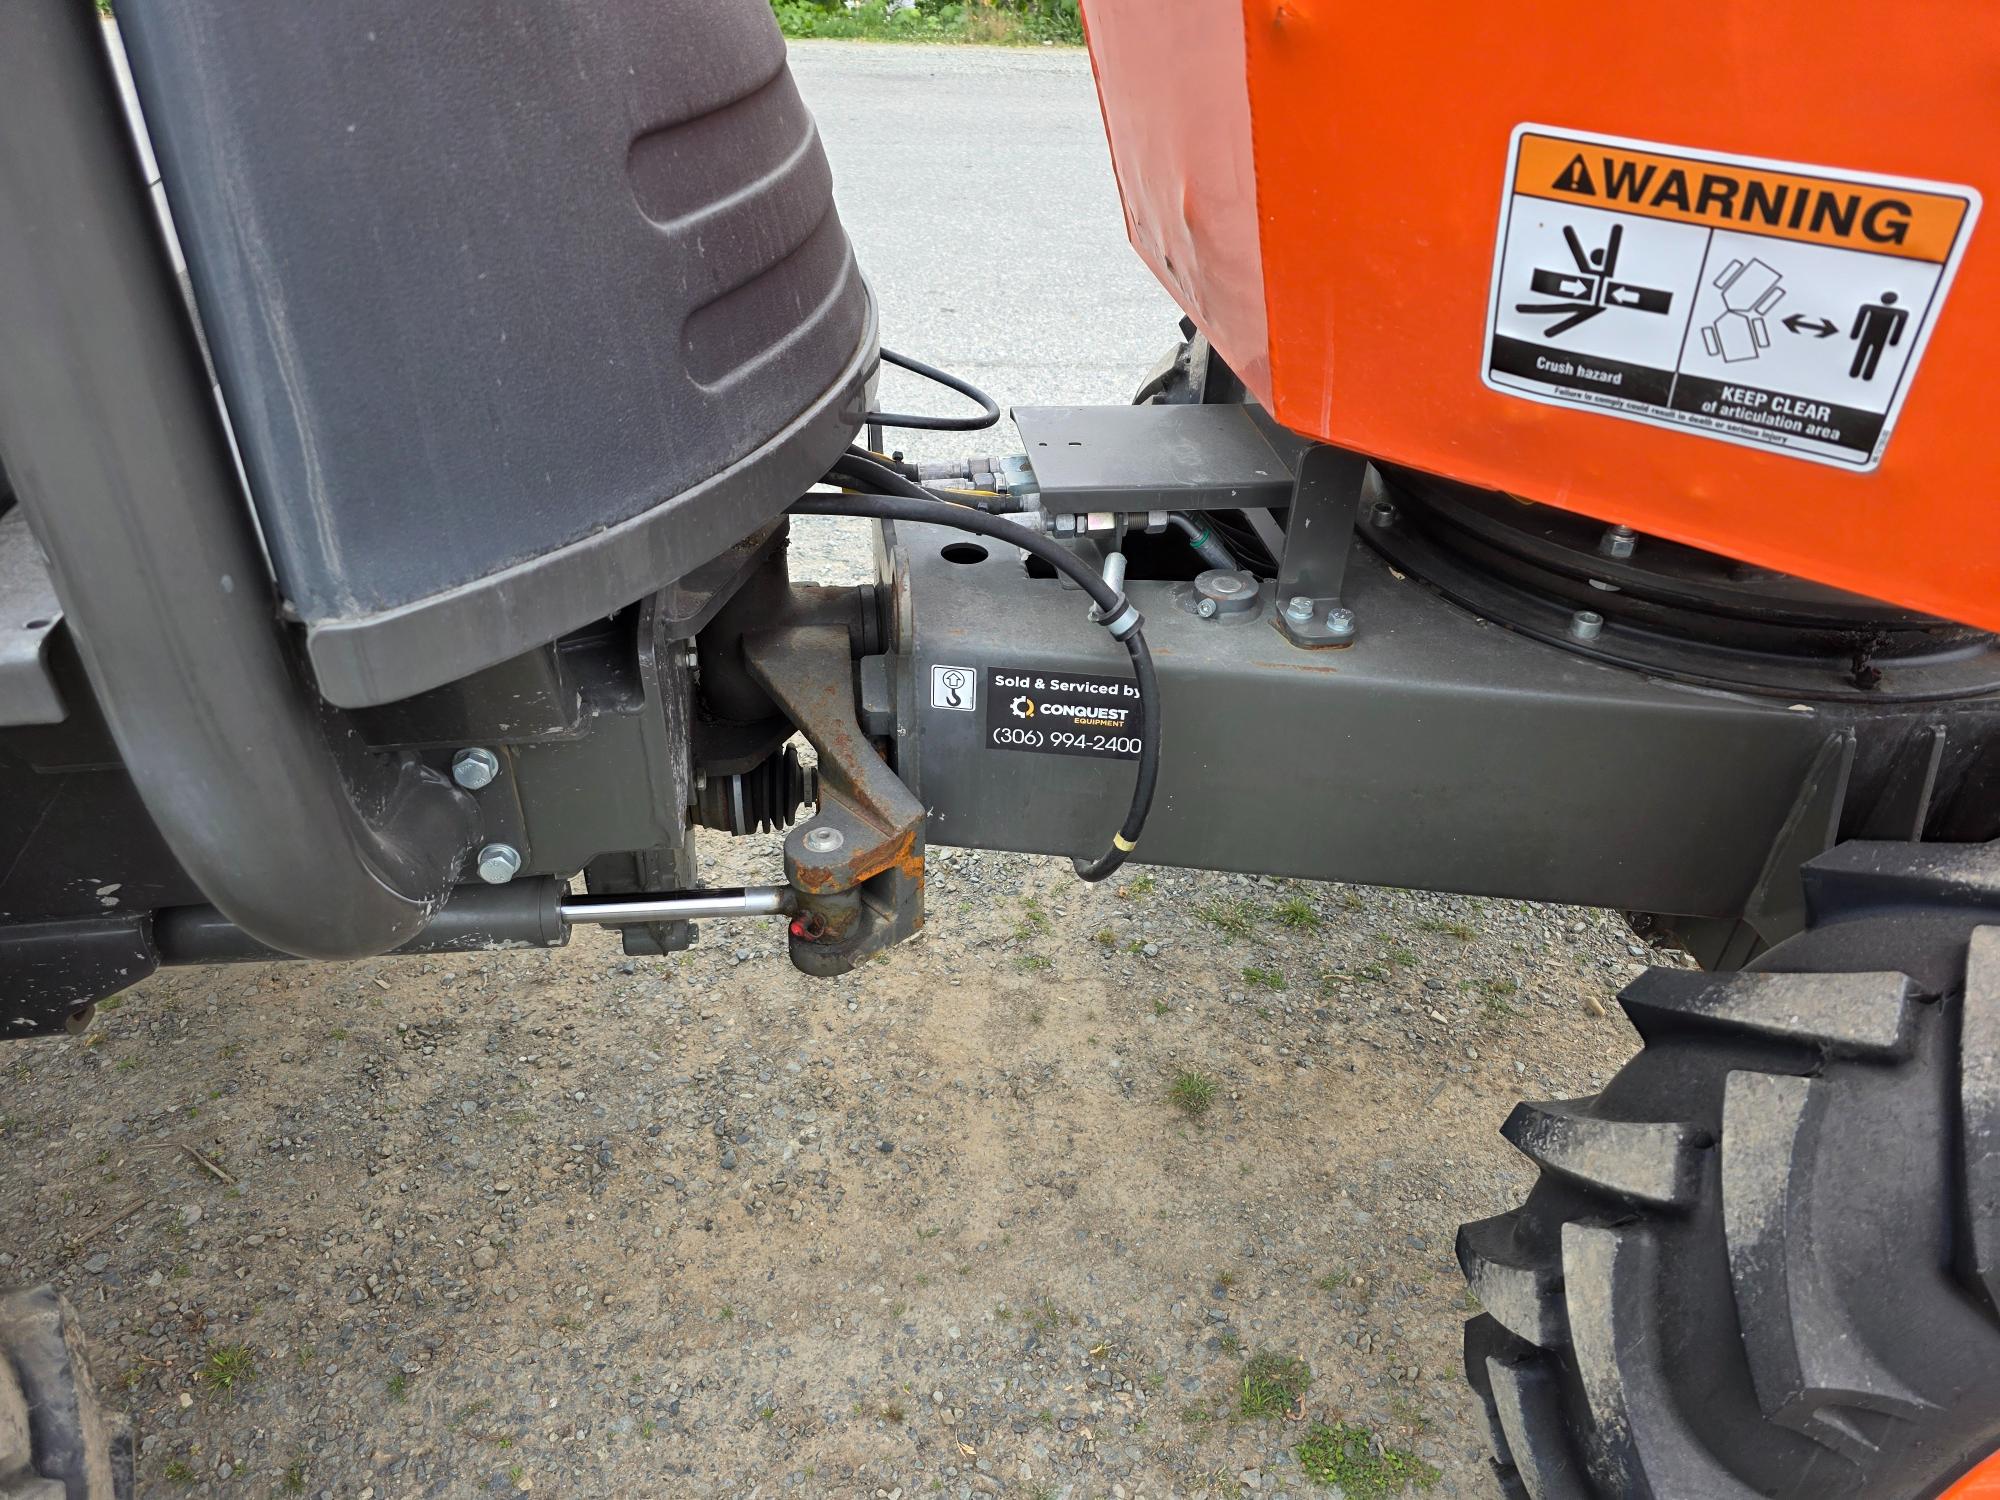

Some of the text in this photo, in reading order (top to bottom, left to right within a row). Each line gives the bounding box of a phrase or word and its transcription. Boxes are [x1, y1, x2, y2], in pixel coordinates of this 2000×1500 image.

[1601, 158, 1913, 246] WARNING
[1536, 356, 1623, 385] Crush hazard
[1721, 386, 1831, 422] KEEP CLEAR
[1701, 401, 1841, 440] of articulation area
[1761, 430, 1788, 444] injury
[995, 675, 1141, 699] Sold & Serviced by
[1040, 703, 1129, 720] CONQUEST
[1074, 717, 1125, 727] EQUIPMENT
[993, 727, 1142, 754] (306) 994-2400
